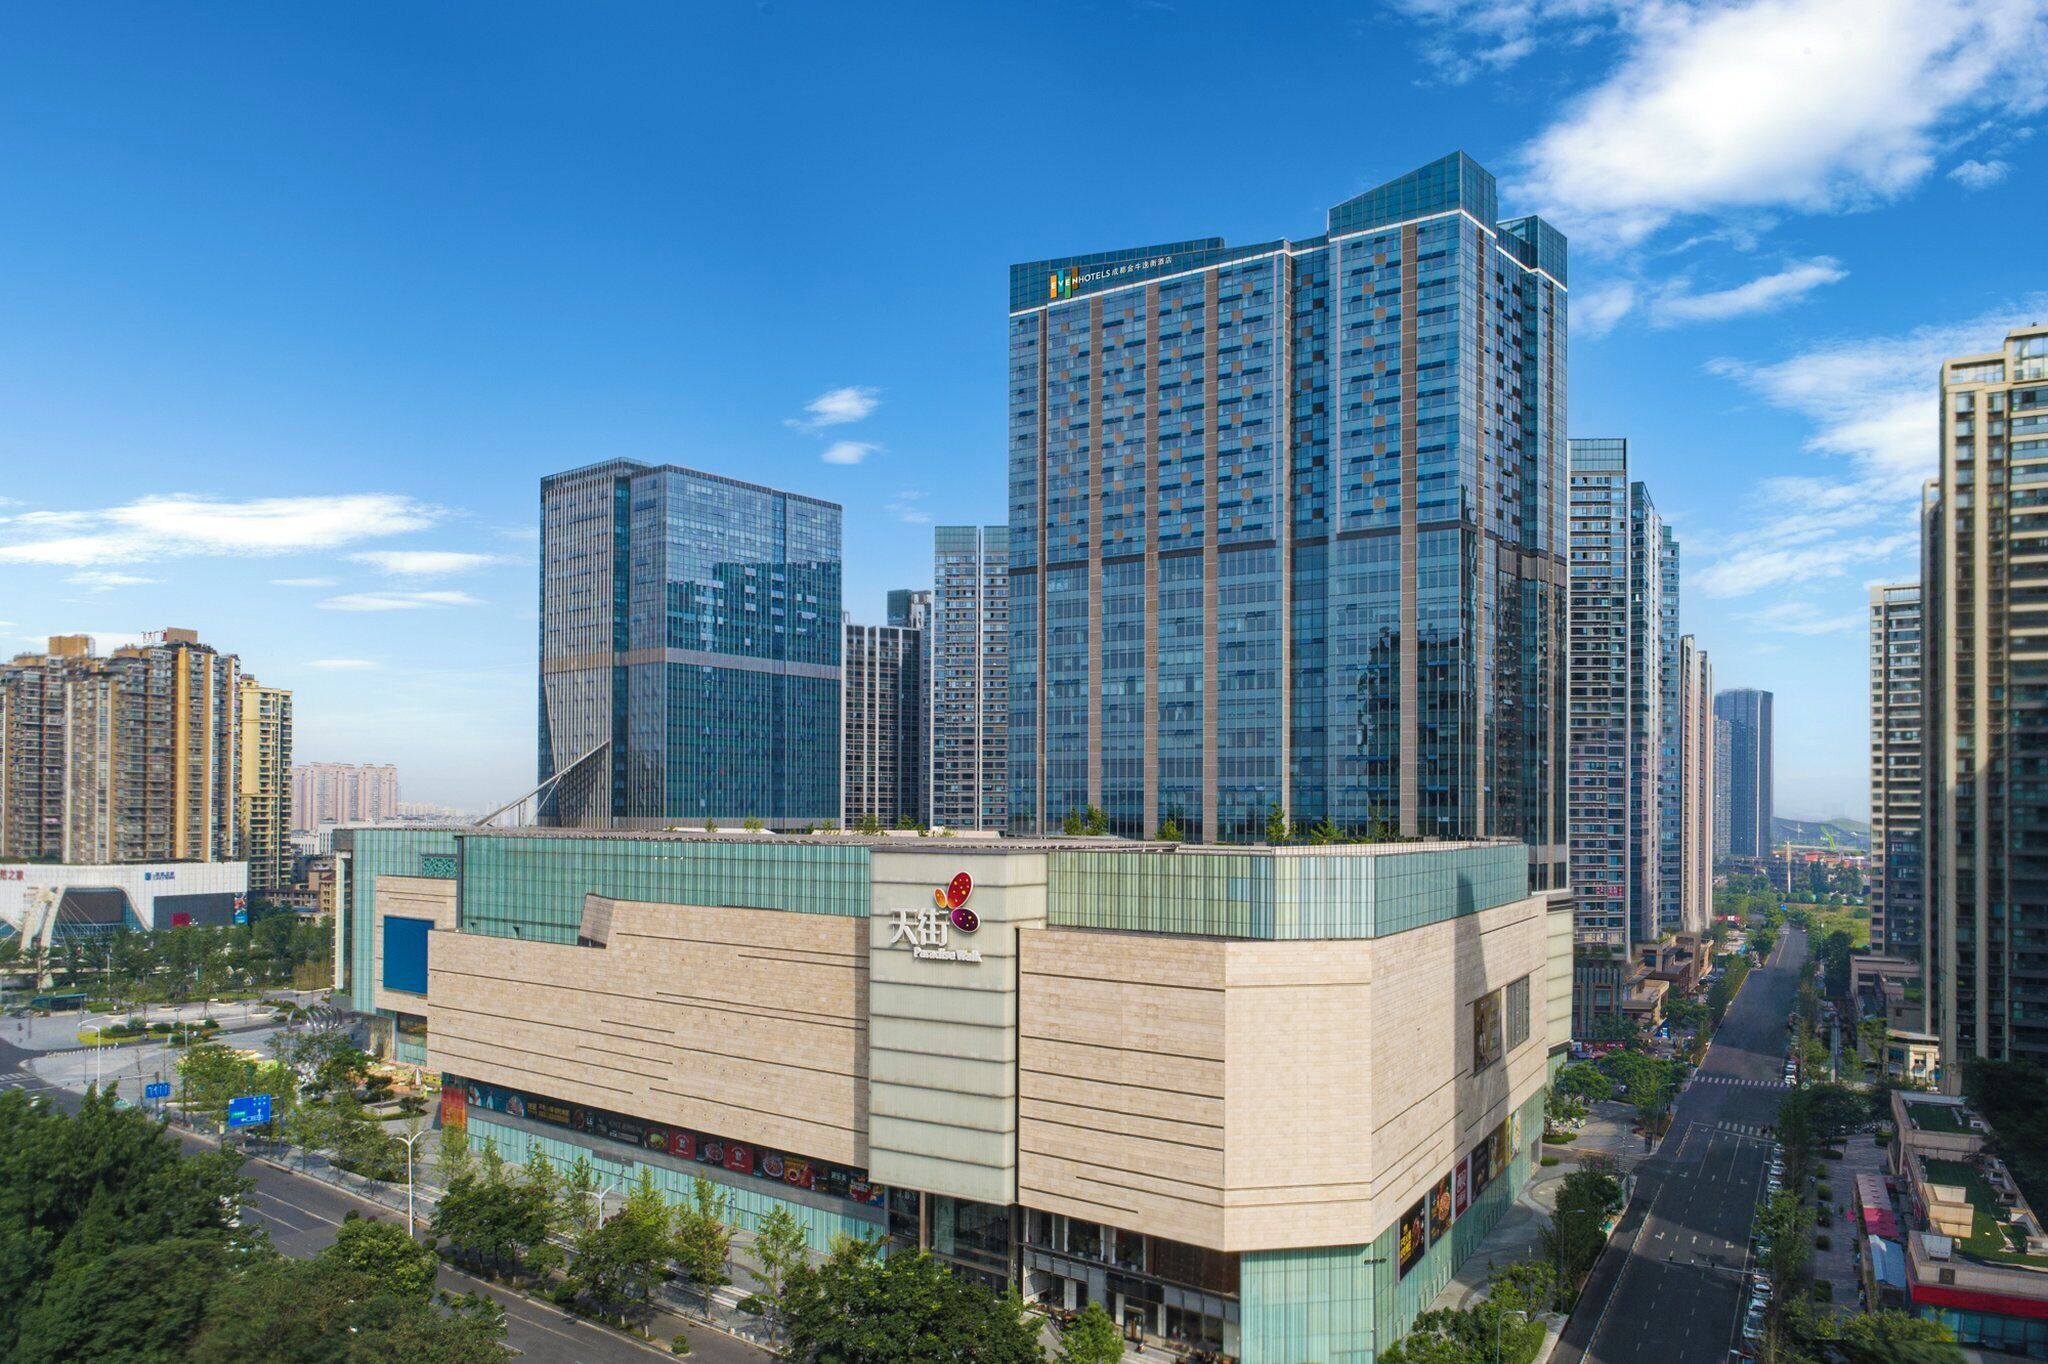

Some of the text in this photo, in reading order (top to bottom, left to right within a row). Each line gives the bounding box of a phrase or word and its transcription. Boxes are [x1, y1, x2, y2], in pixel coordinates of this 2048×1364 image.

[1079, 269, 1110, 283] HOTELS
[889, 907, 950, 947] 天街
[913, 946, 956, 960] Paradise
